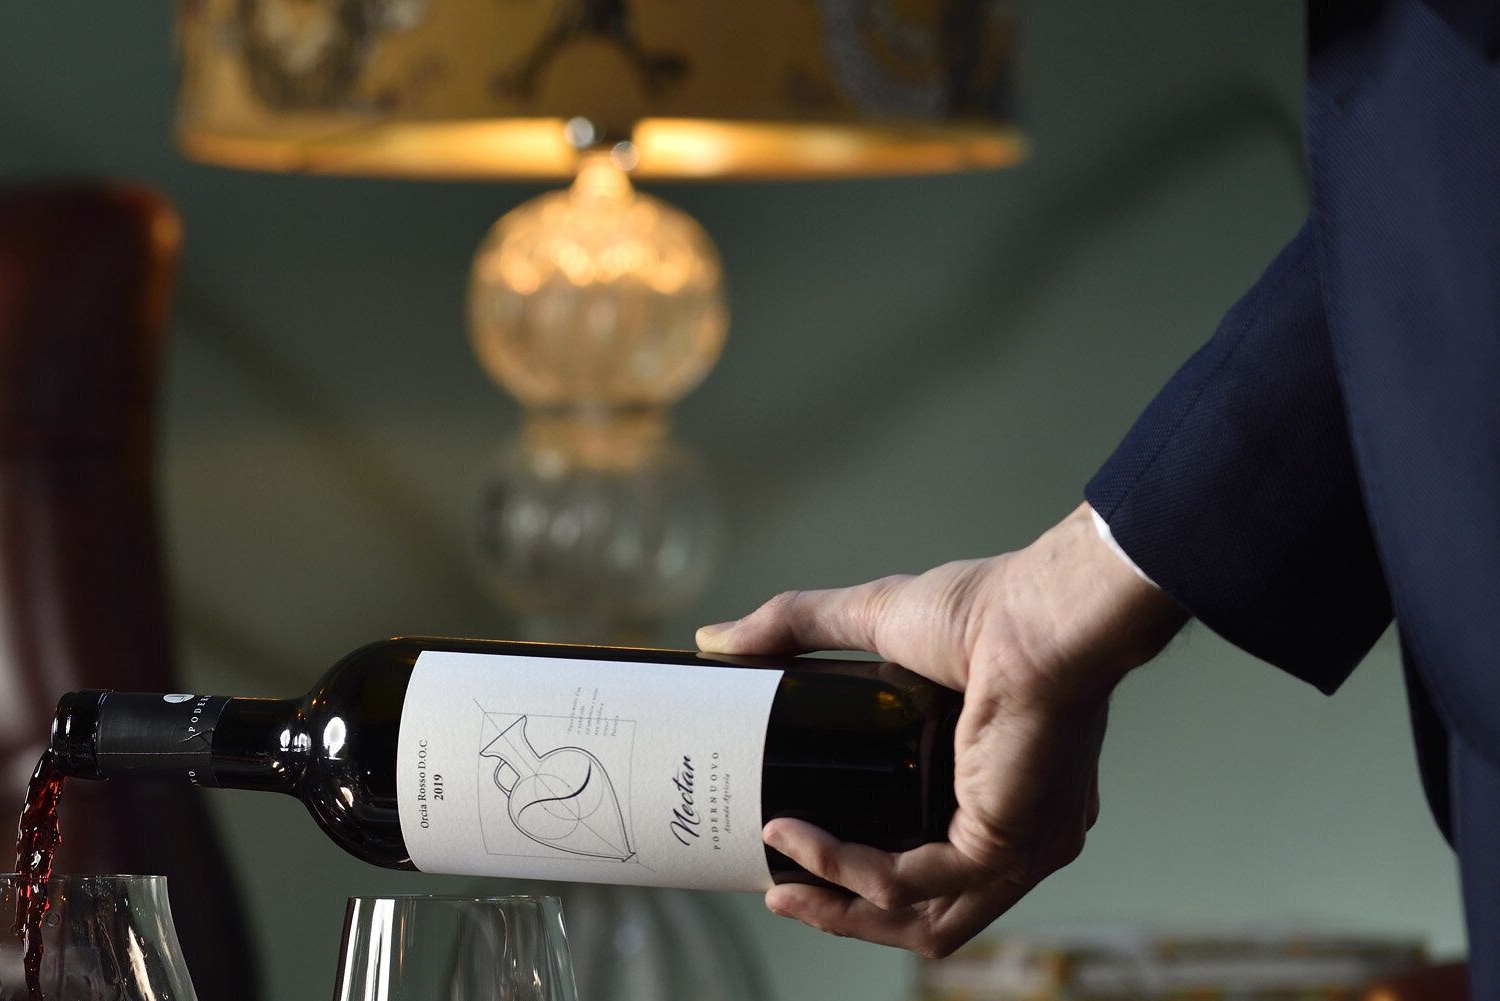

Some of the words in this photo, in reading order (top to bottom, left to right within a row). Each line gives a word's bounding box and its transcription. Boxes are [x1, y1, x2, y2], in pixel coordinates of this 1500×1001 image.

[417, 771, 426, 802] Rosso
[433, 774, 445, 801] 2019
[669, 754, 701, 847] Nectar
[709, 752, 721, 850] PODERNUOVO
[418, 803, 430, 829] Orcia
